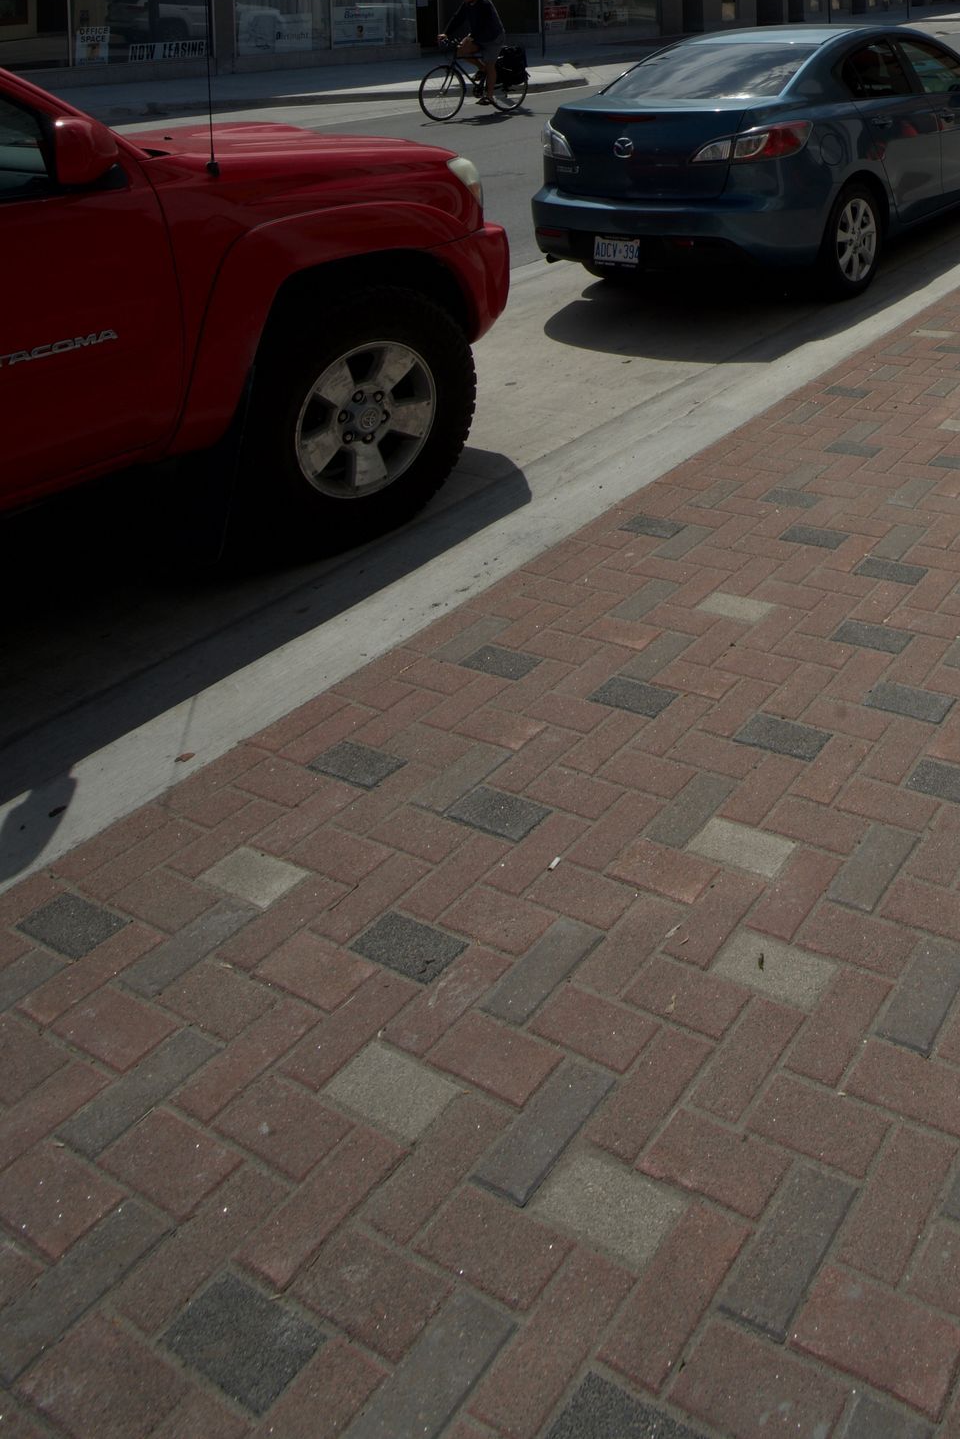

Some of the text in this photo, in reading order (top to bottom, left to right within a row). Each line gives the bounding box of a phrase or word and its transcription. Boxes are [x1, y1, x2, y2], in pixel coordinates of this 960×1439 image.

[80, 27, 108, 35] OFFICE
[80, 35, 106, 43] SPACE
[130, 44, 156, 61] NOW
[0, 328, 119, 368] TACOMA
